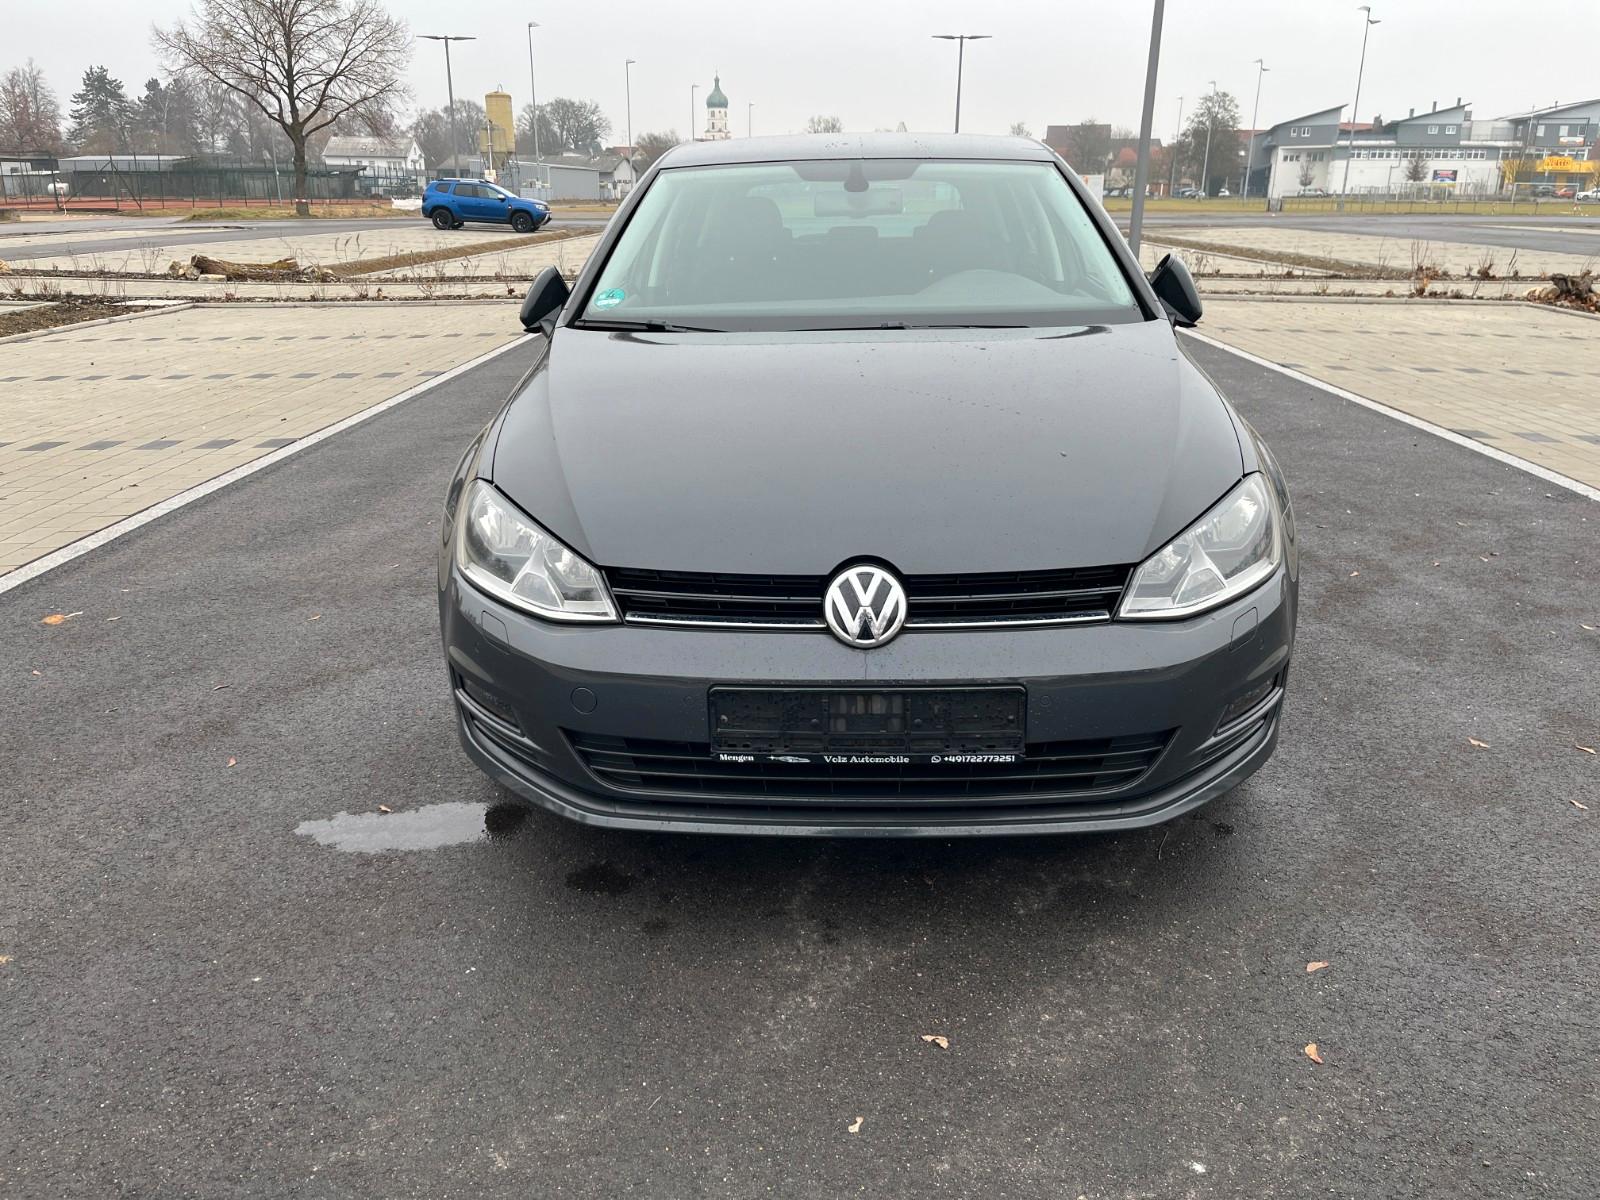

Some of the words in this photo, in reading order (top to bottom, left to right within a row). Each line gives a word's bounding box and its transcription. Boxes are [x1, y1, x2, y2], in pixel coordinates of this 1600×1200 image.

[719, 754, 754, 763] Mengen
[824, 755, 848, 763] Volz
[849, 755, 910, 763] Automobile
[943, 755, 1016, 763] +491722773251
